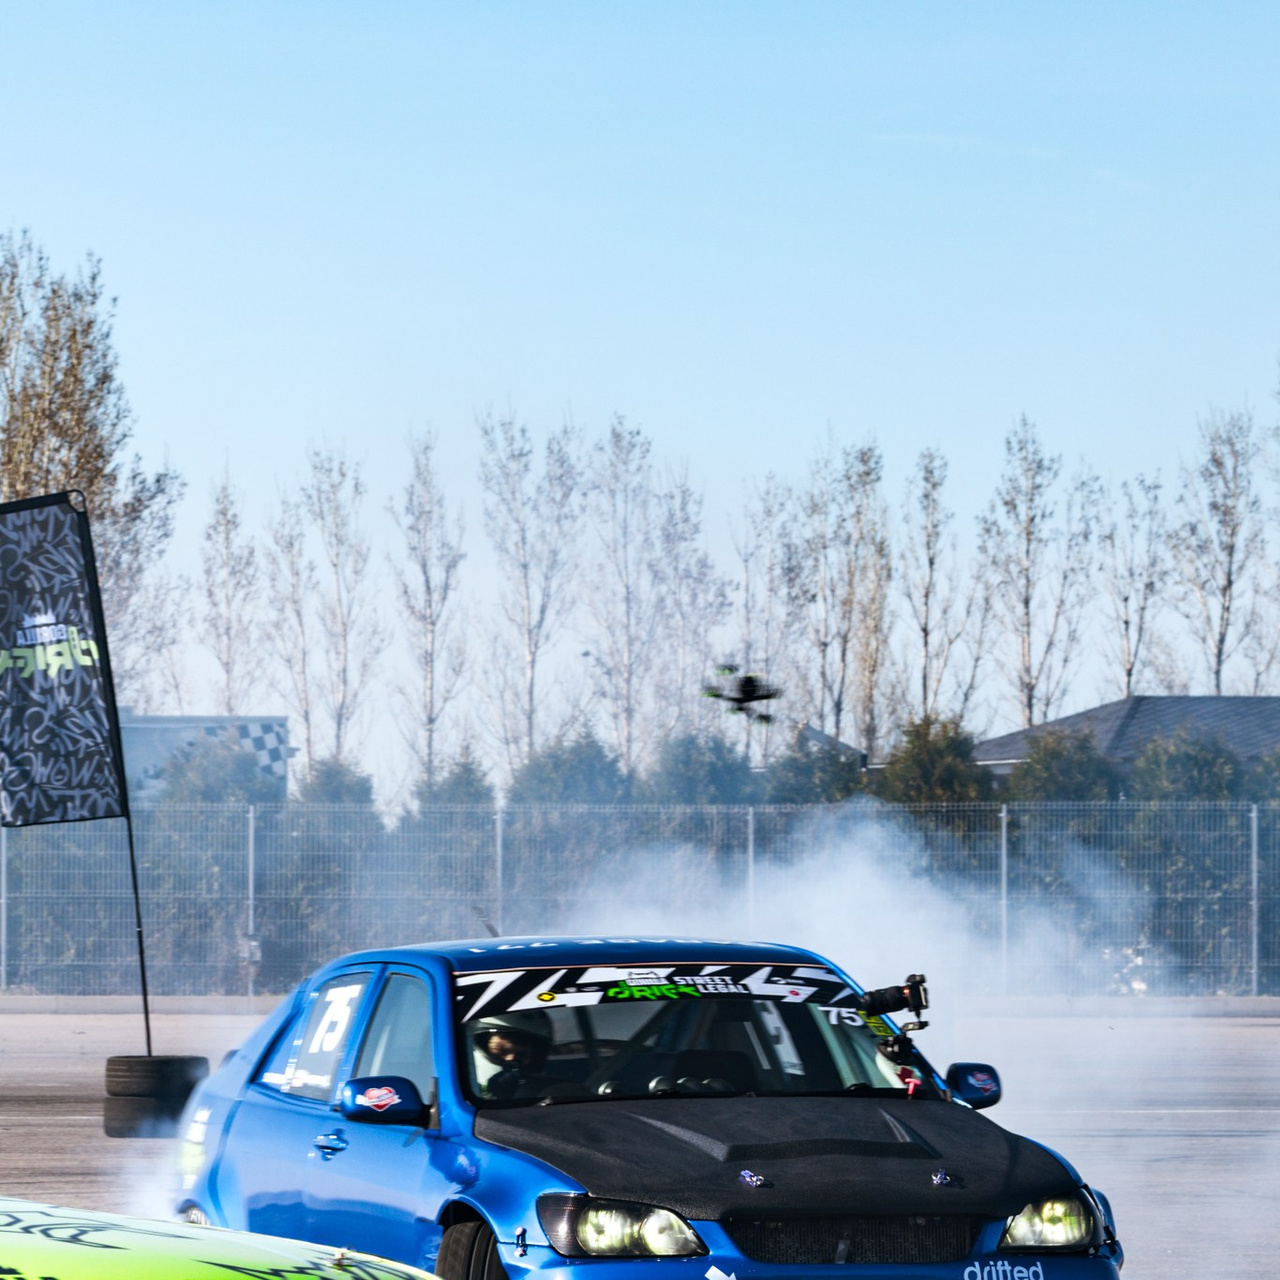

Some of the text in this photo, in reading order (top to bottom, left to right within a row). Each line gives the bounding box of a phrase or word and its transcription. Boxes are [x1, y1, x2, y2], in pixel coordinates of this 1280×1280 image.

[672, 976, 733, 985] STREET
[696, 984, 751, 993] LEGAL
[308, 985, 362, 1053] 75
[817, 1006, 865, 1026] 75
